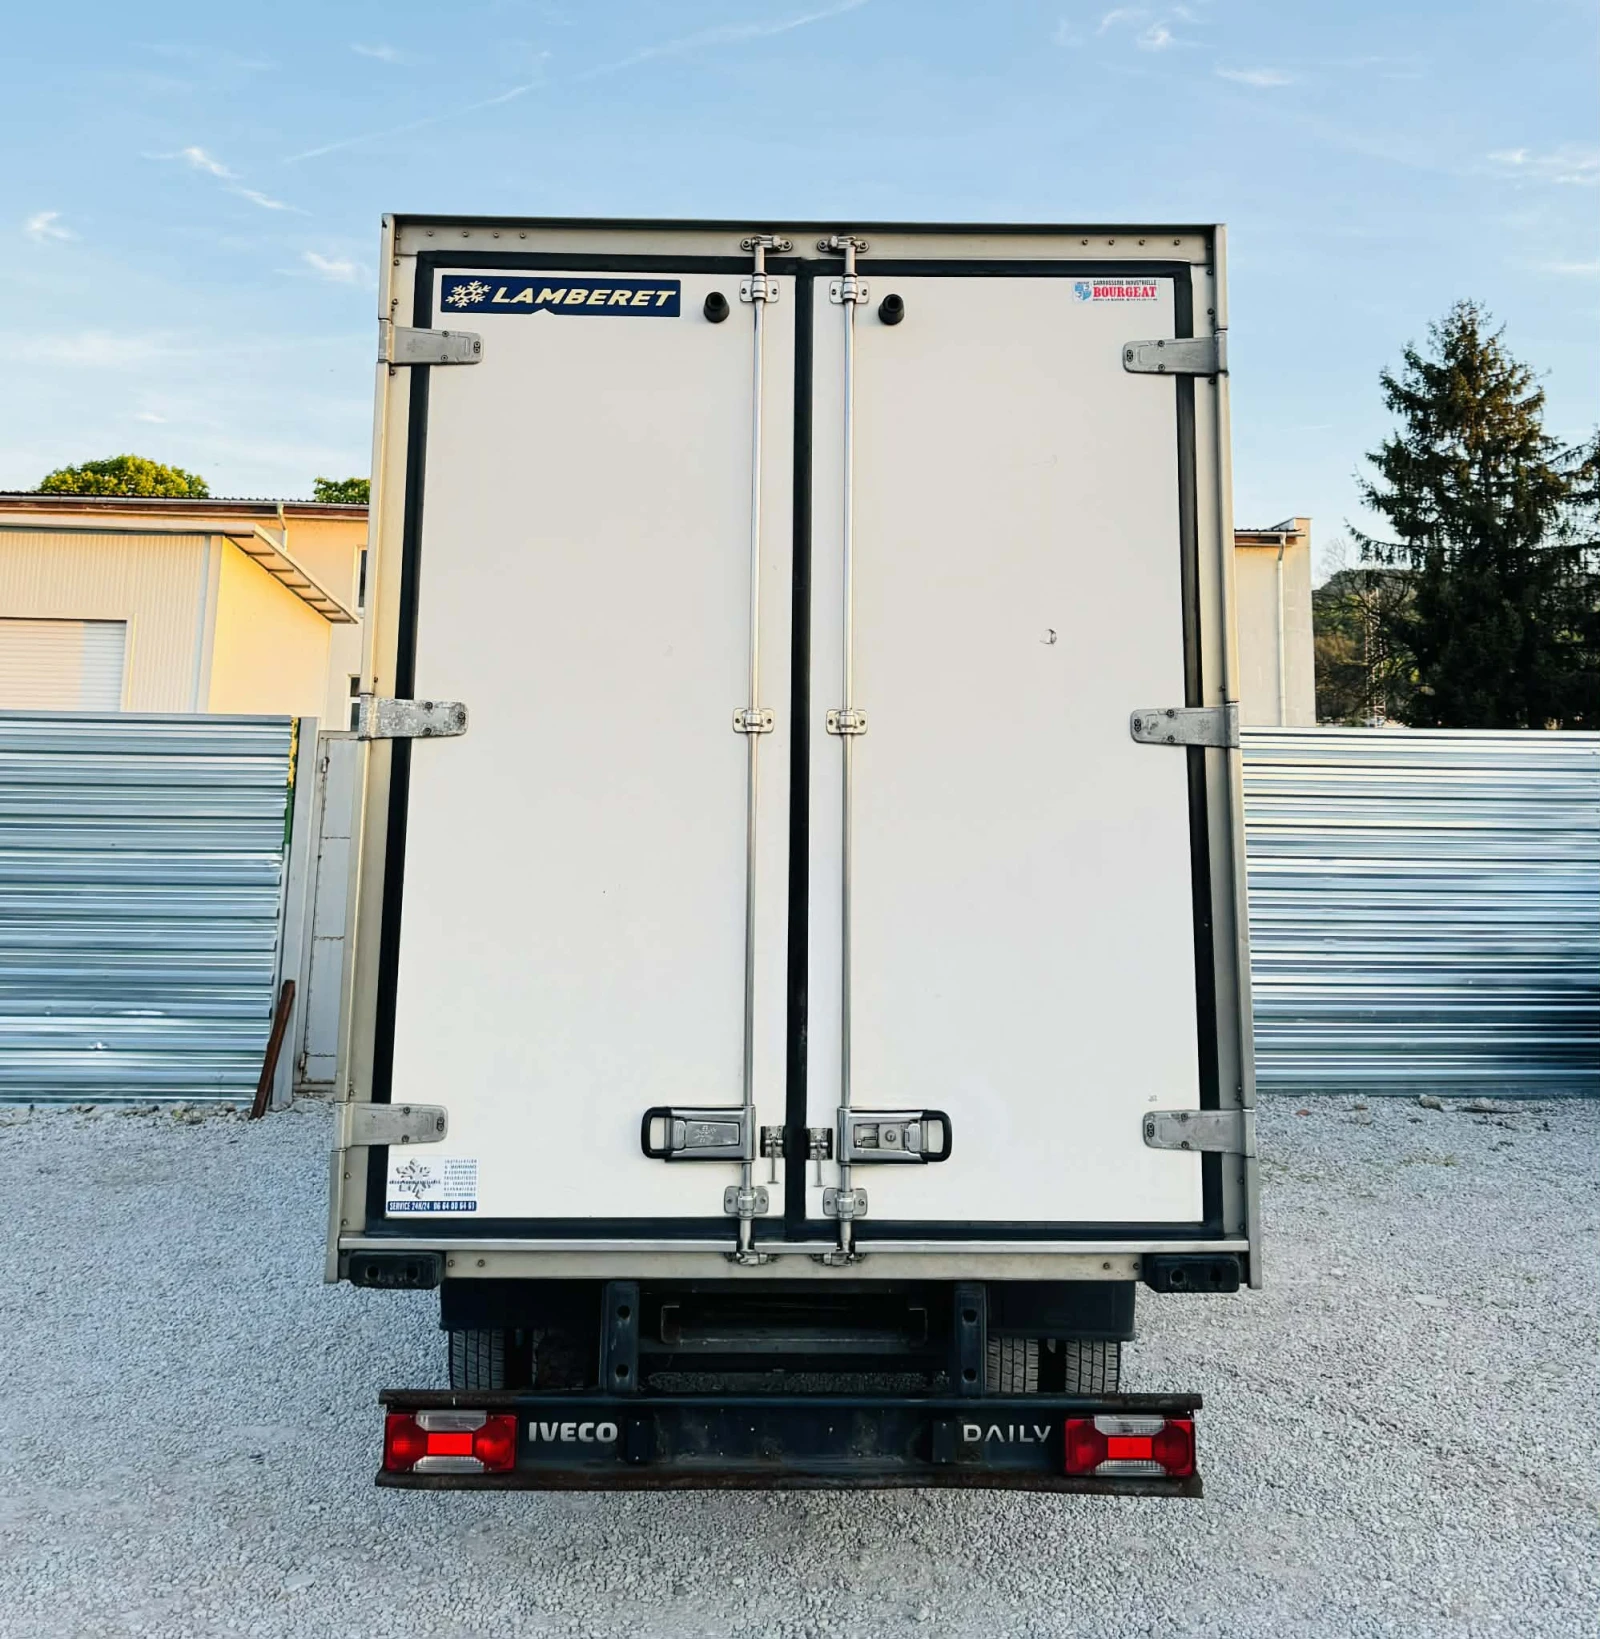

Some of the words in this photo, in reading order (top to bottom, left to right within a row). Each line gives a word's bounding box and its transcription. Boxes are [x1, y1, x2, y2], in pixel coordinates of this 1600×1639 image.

[491, 286, 677, 307] LAMBERET
[1093, 286, 1157, 298] BOURGEAT
[389, 1201, 410, 1211] SERVICE
[528, 1421, 618, 1443] IVECO
[963, 1424, 1052, 1443] DAILY
